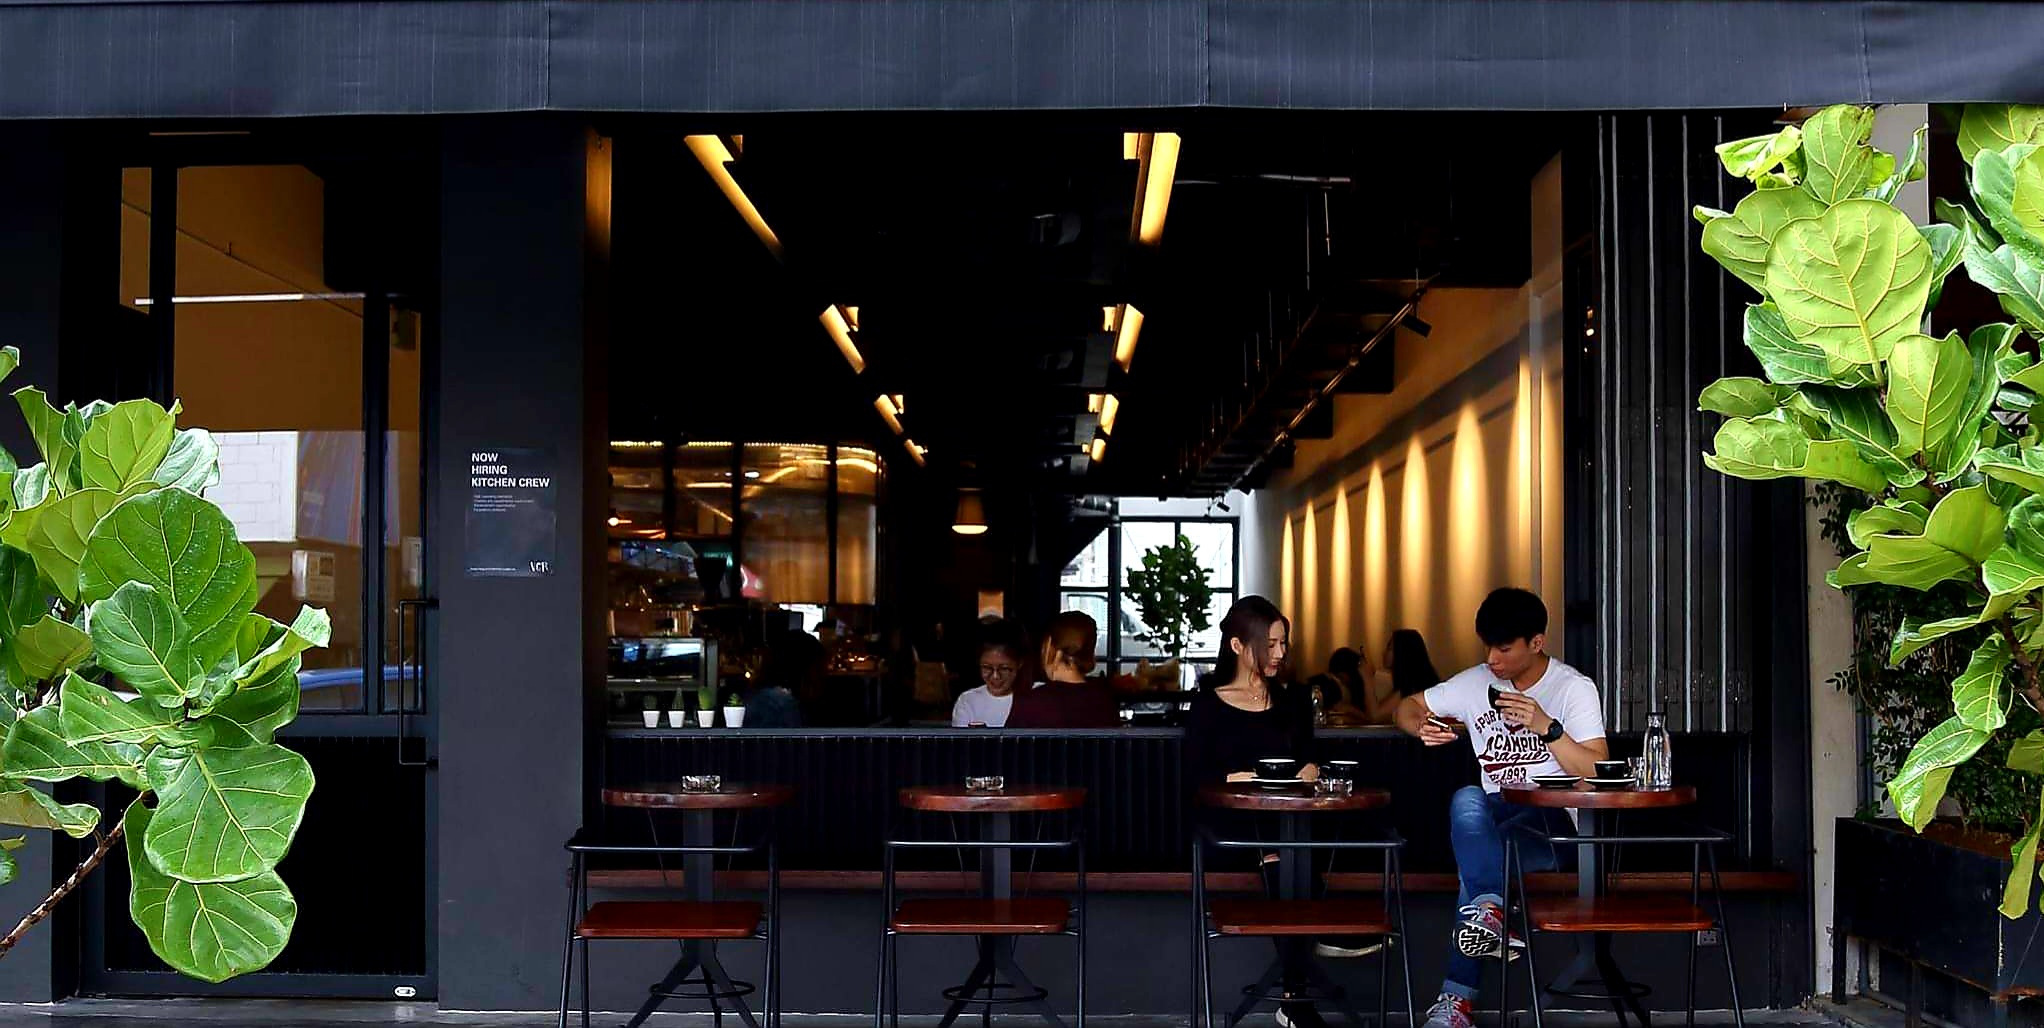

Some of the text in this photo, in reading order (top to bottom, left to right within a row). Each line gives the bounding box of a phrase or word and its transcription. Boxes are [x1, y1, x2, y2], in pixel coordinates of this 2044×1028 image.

[471, 452, 499, 462] NOW
[471, 465, 508, 475] HIRING
[471, 478, 550, 487] KITCHEN CREW
[1494, 734, 1546, 752] CAMPUS
